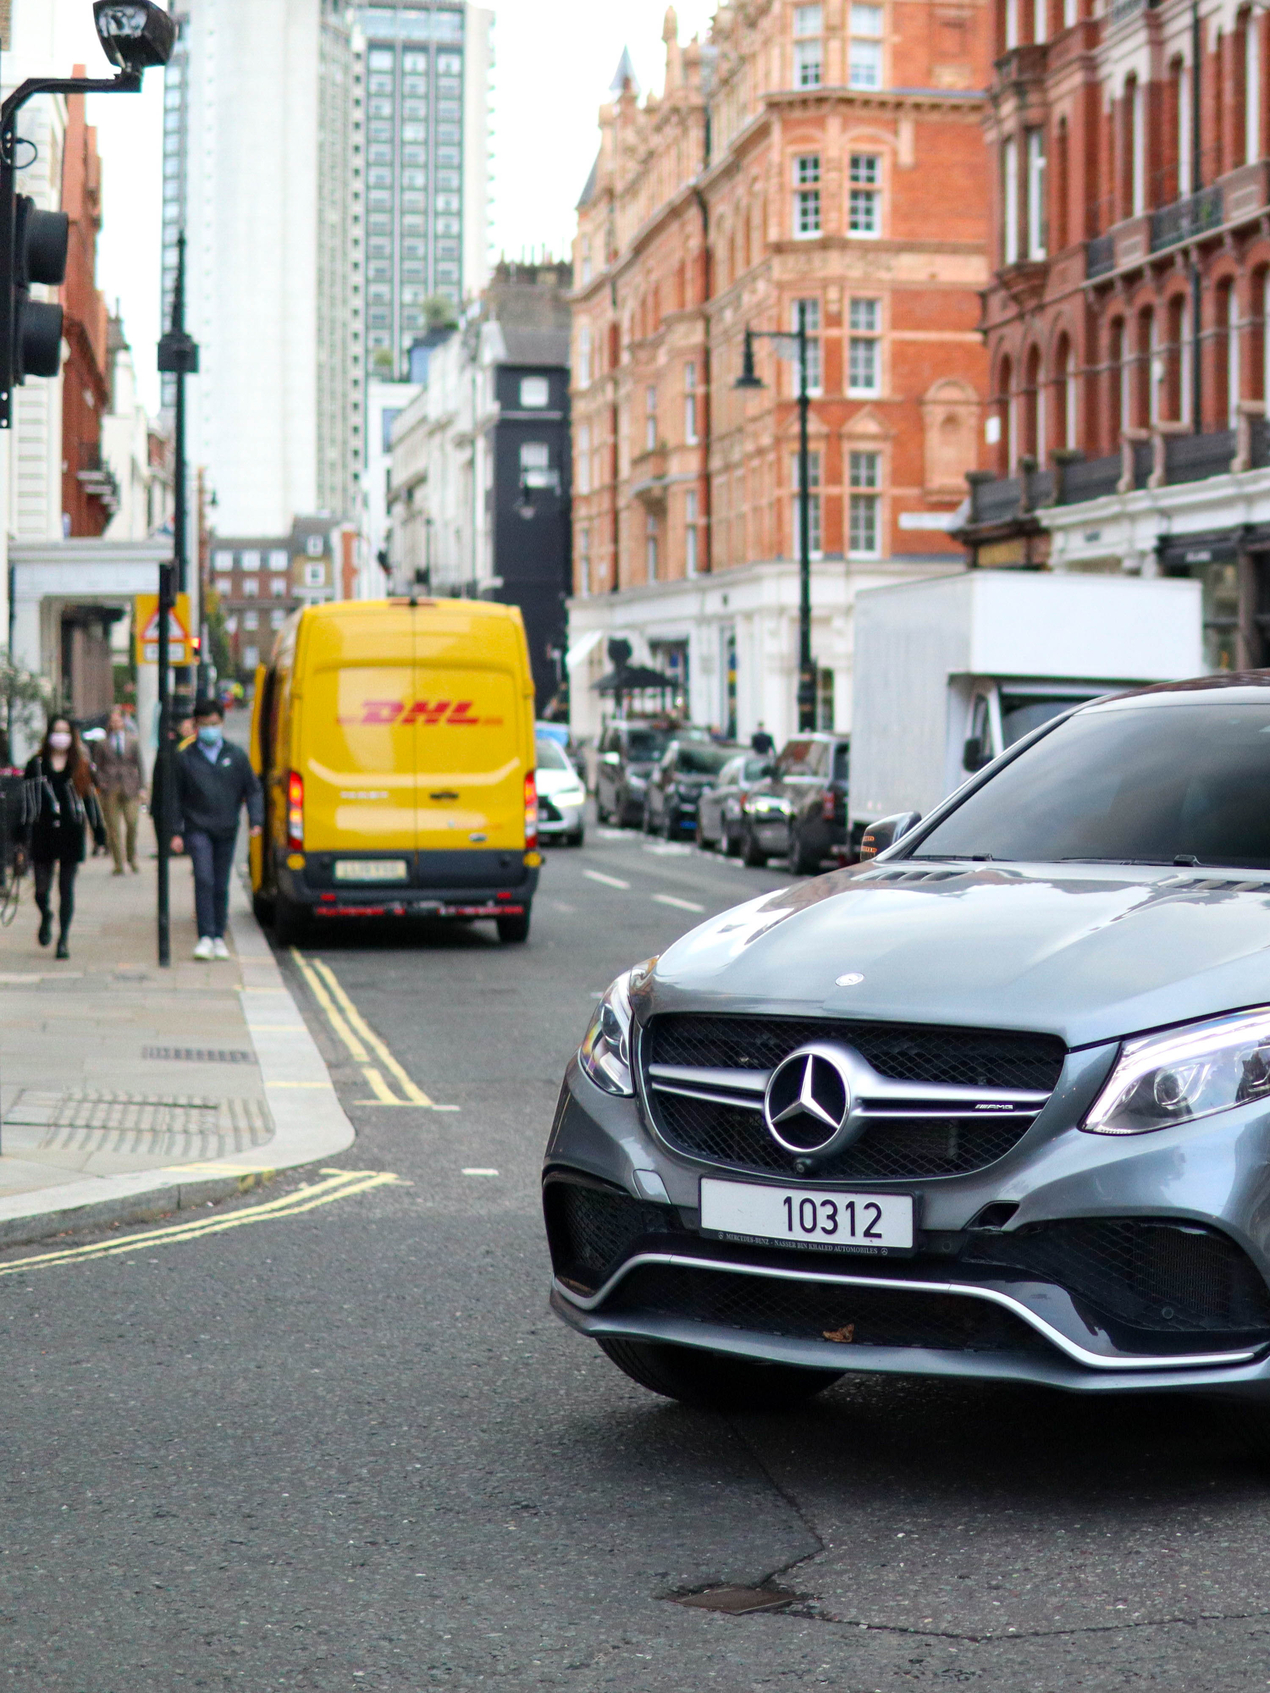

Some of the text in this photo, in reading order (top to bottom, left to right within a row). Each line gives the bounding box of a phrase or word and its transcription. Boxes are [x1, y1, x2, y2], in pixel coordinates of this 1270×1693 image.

[360, 700, 480, 725] DHL
[783, 1196, 883, 1239] 10312
[726, 1233, 770, 1246] MERCEDES-BENZ
[774, 1239, 797, 1249] NASSER
[808, 1244, 834, 1252] KHALED
[834, 1246, 878, 1255] AUTOMOBILES
